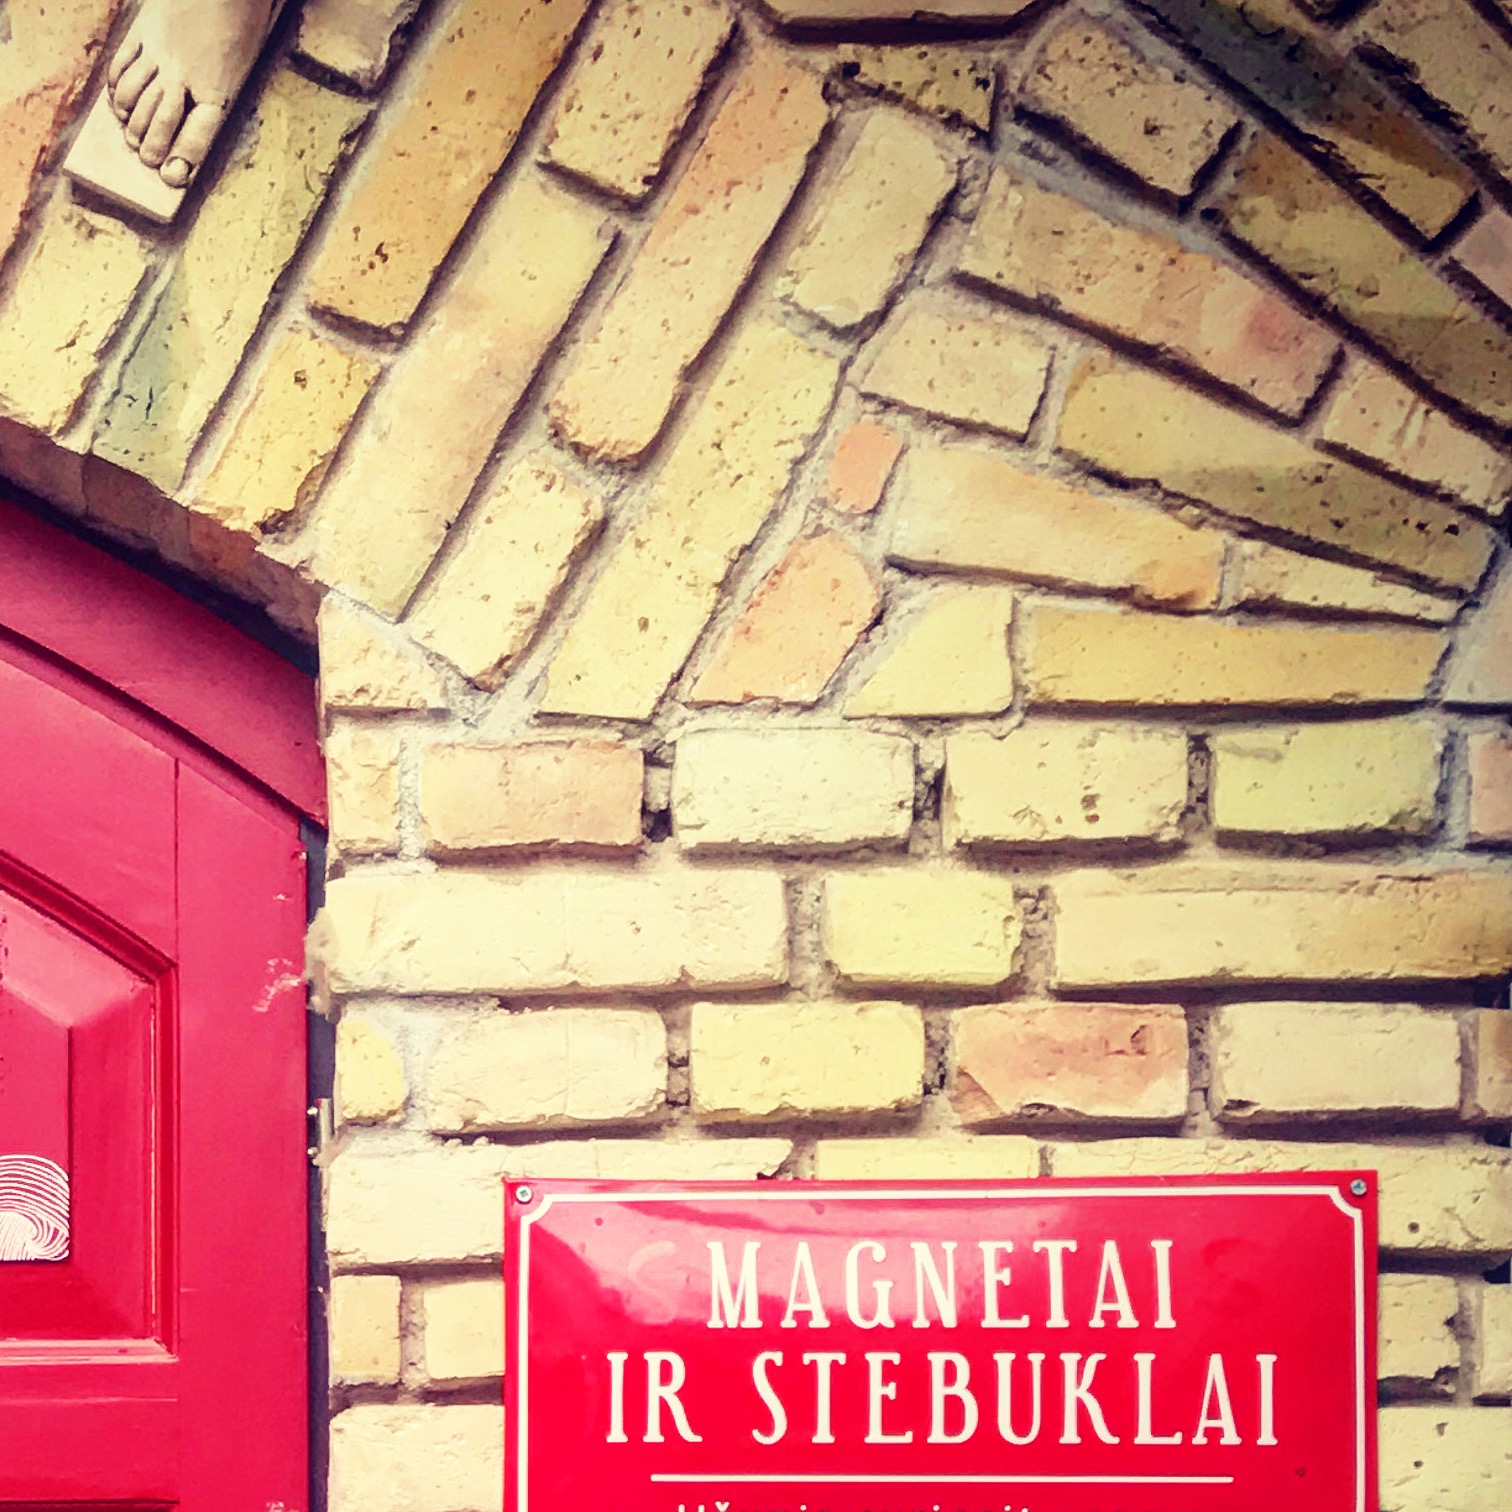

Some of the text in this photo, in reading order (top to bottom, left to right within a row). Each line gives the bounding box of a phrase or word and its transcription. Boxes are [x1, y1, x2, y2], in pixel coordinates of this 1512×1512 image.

[706, 1239, 1177, 1330] MAGNETAI
[604, 1350, 1279, 1447] IR STEBUKLAI
